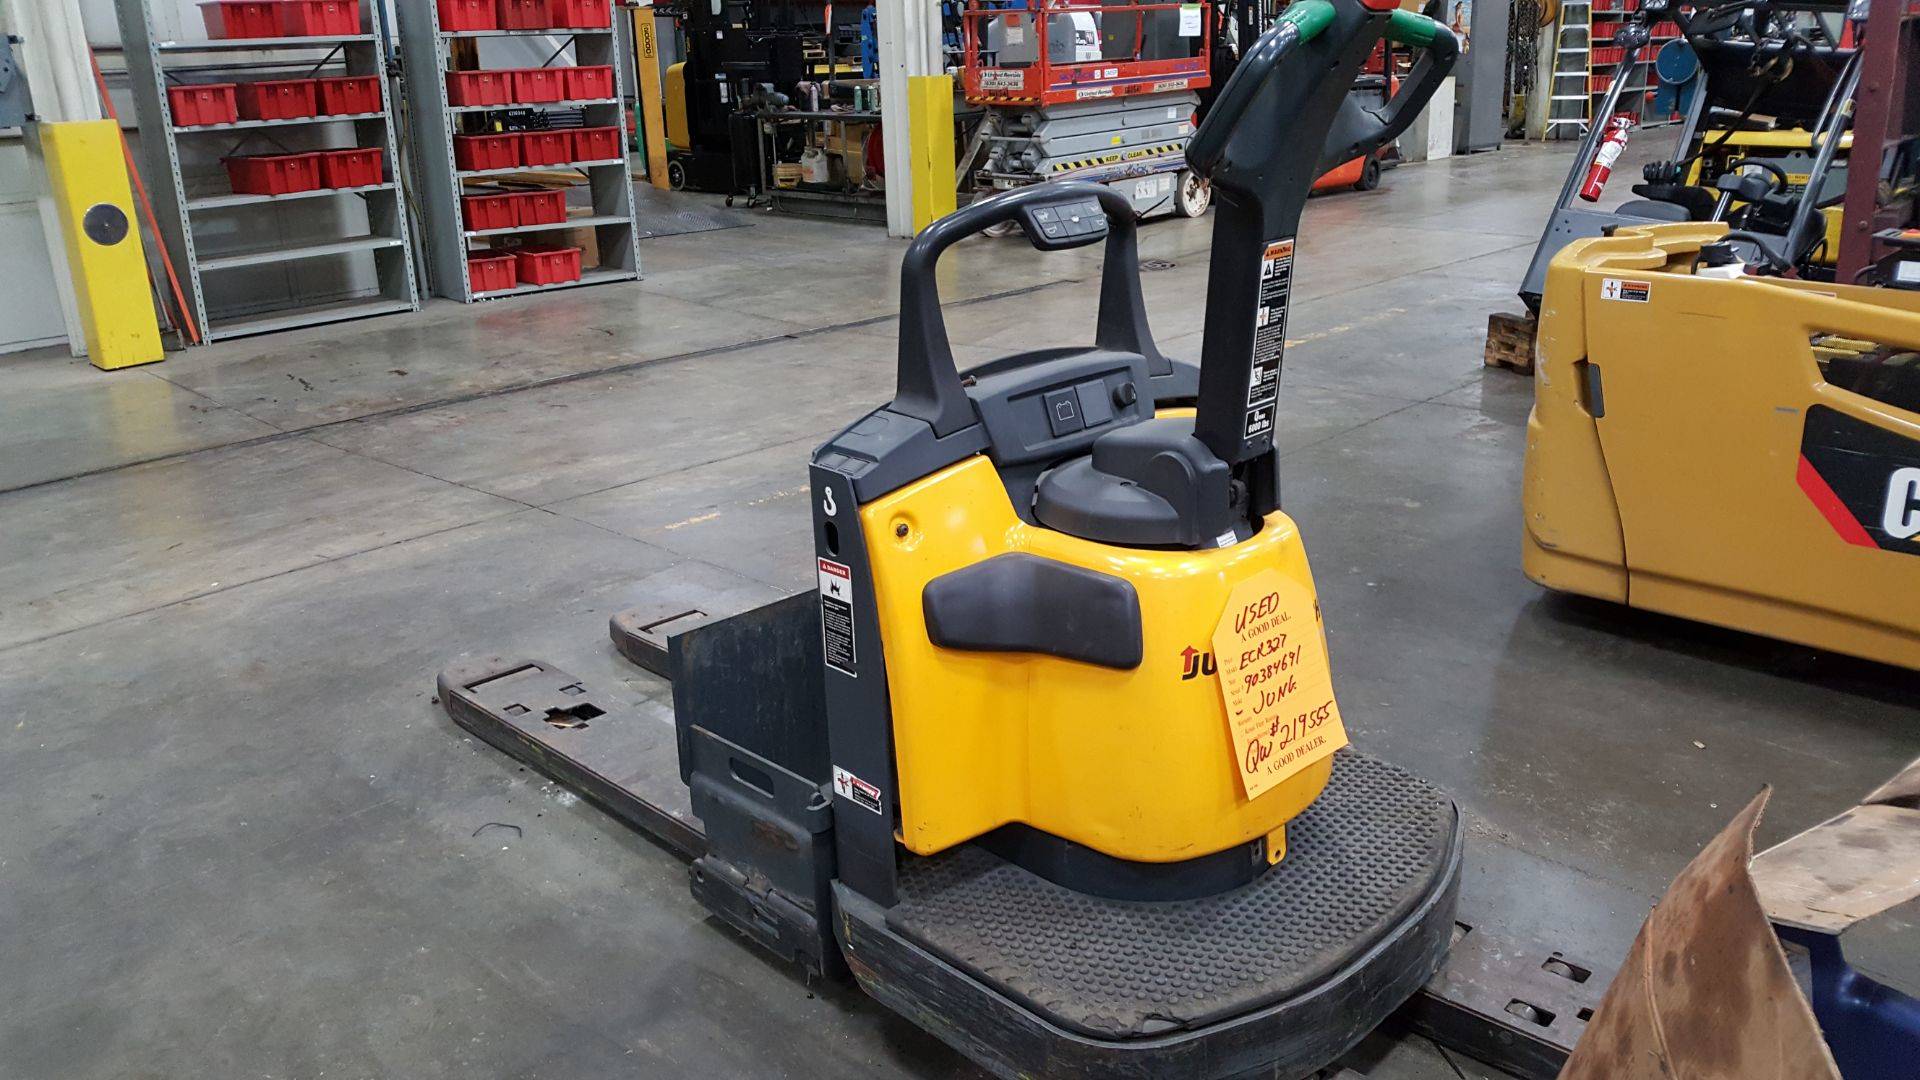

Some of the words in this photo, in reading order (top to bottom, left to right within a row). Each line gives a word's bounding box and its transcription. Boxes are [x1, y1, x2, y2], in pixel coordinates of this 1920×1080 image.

[1105, 154, 1118, 163] KEEP
[1127, 151, 1143, 160] CLEAR
[827, 564, 847, 576] DANGER
[1235, 591, 1279, 634] USED
[1241, 633, 1247, 643] A
[1248, 620, 1270, 640] GOOD
[1271, 611, 1292, 631] DEAL.
[1266, 764, 1273, 776] A
[1274, 752, 1295, 771] GOOD
[1295, 735, 1327, 761] DEALER.
